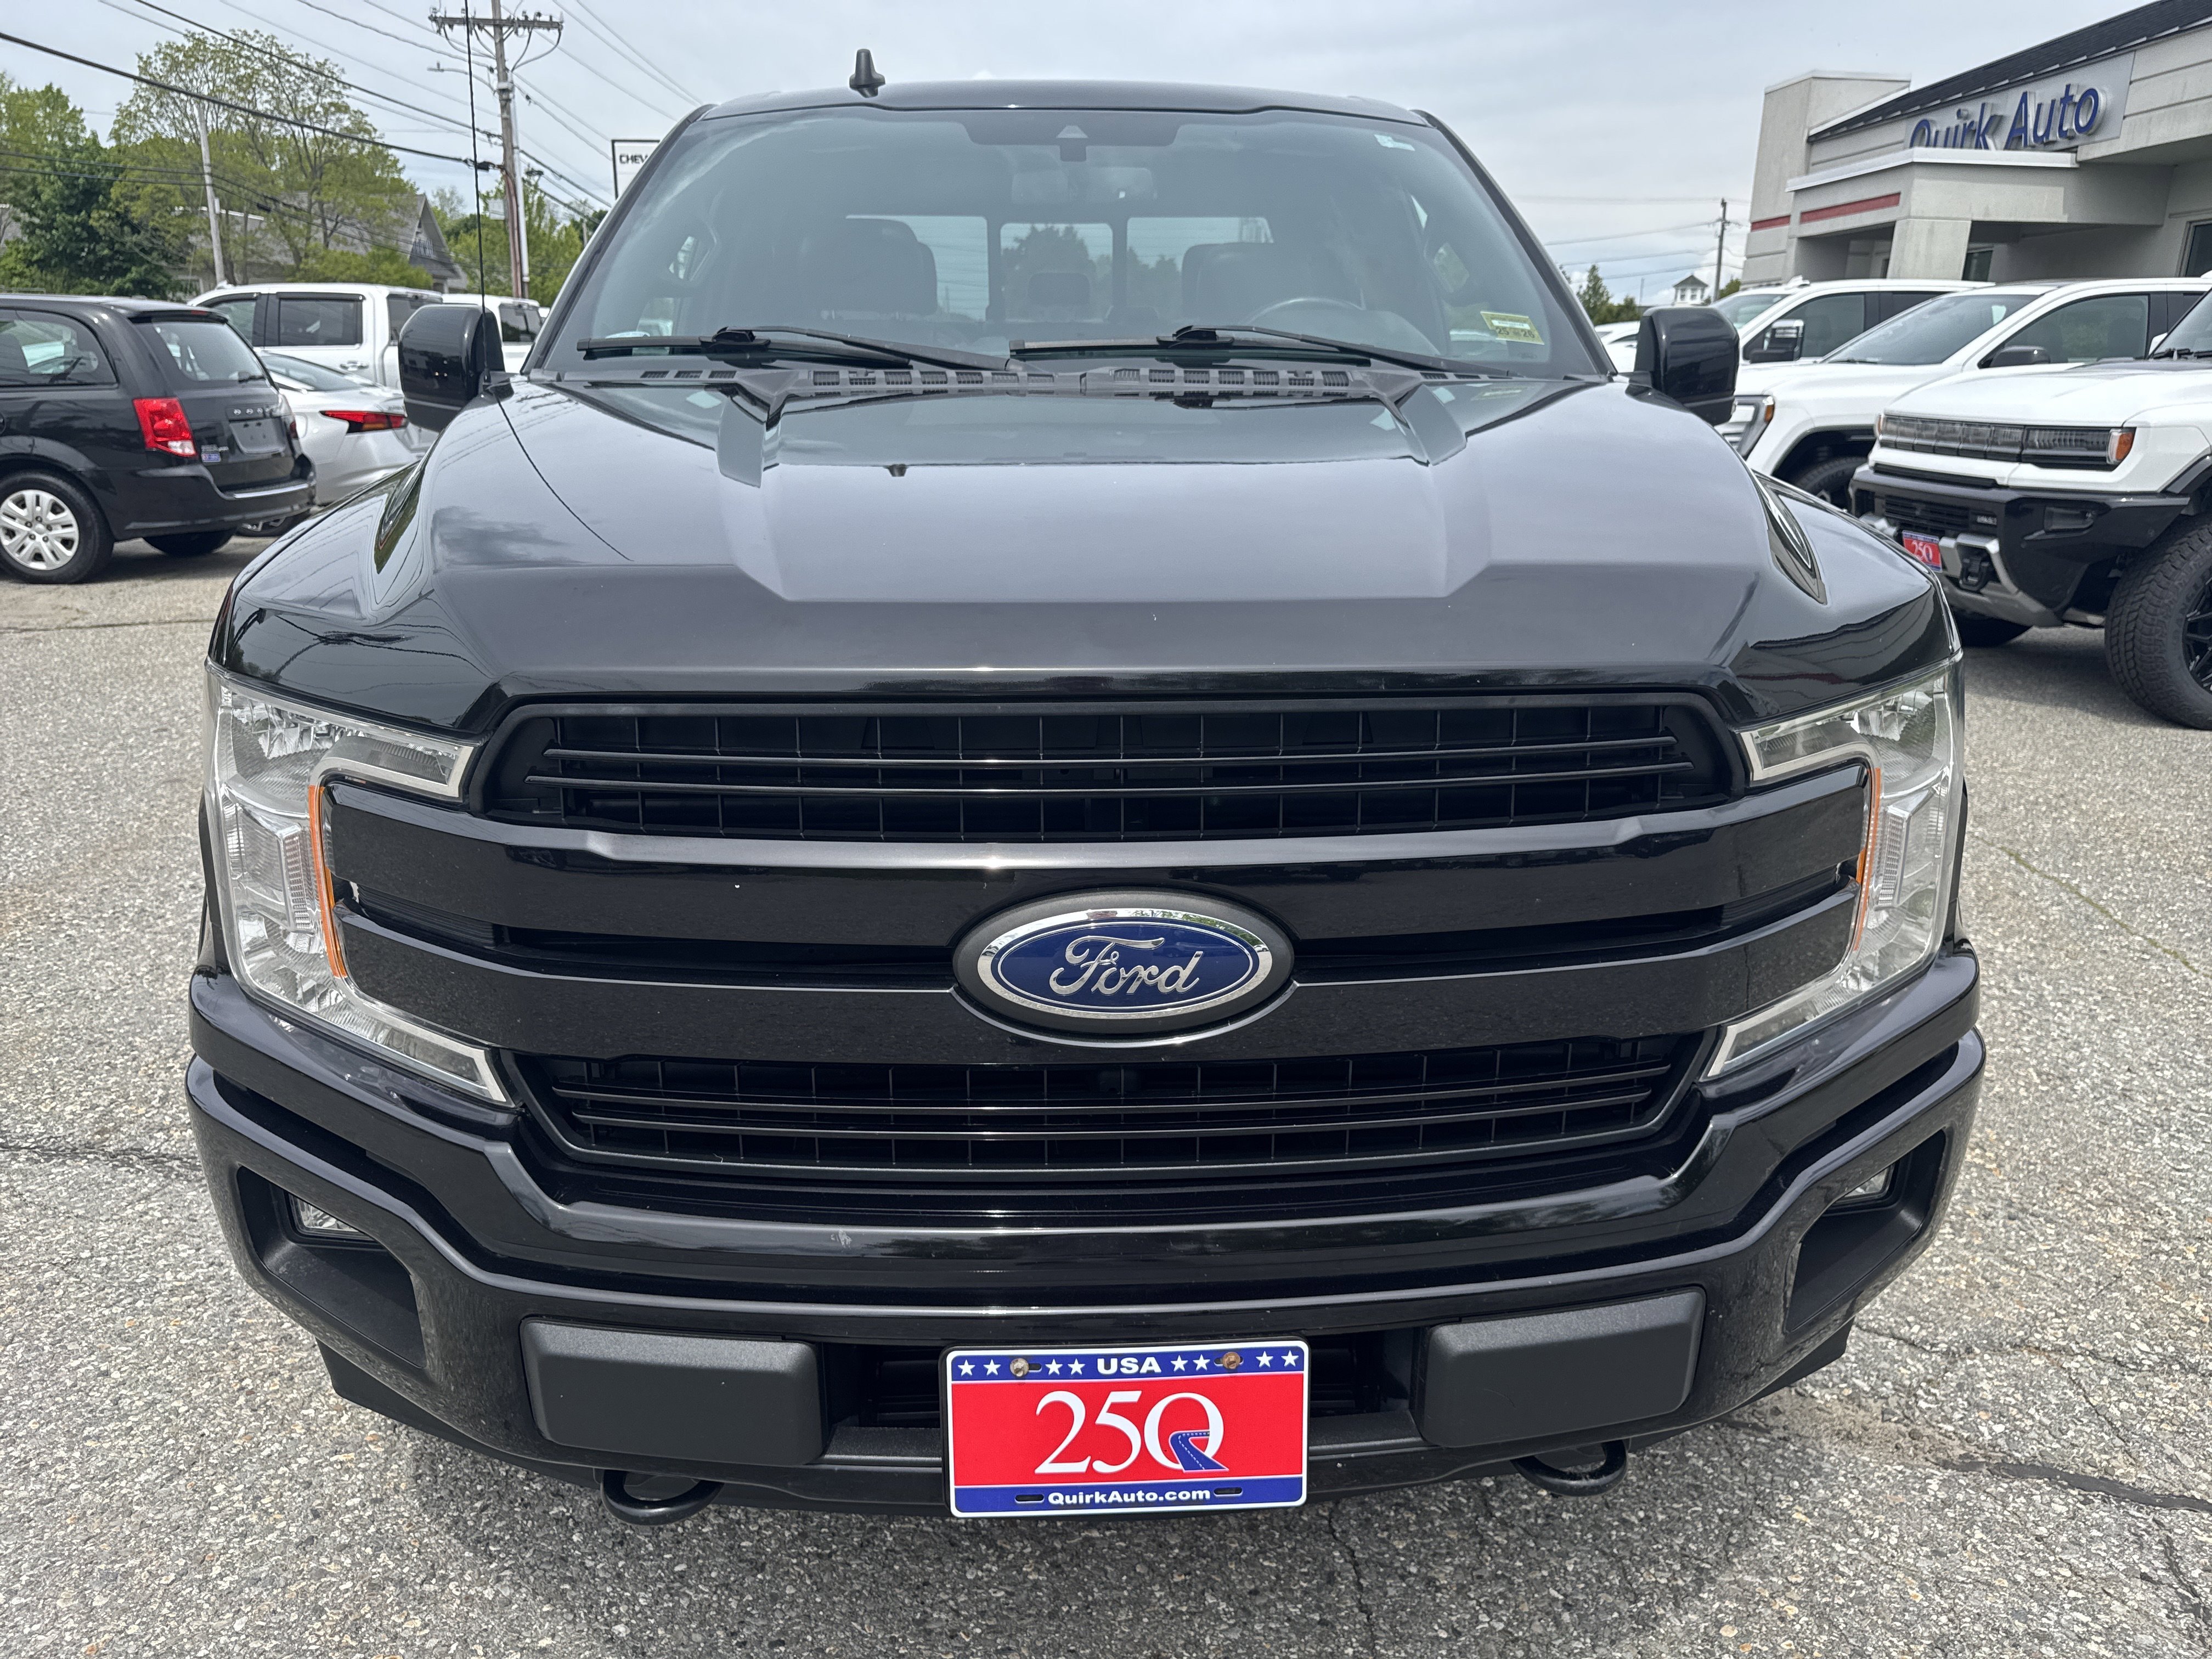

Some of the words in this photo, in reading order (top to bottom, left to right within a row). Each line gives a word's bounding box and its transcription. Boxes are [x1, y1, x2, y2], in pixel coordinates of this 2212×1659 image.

[1910, 102, 2002, 150] Quirk
[2004, 83, 2106, 150] Auto
[1048, 935, 1203, 995] Ford
[1097, 1356, 1162, 1375] USA
[1048, 1489, 1211, 1505] QuirkAuto.com
